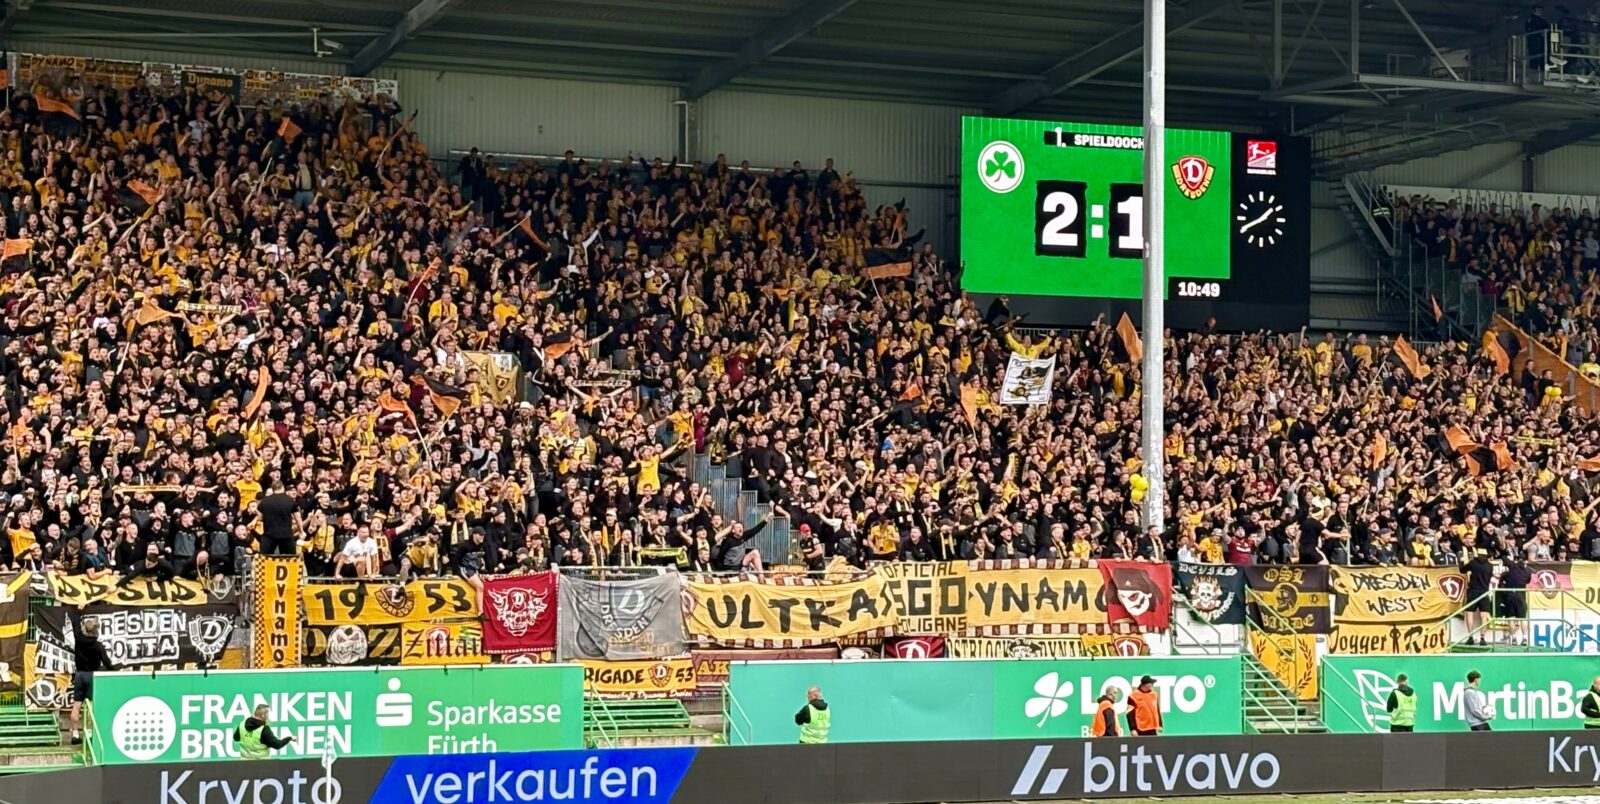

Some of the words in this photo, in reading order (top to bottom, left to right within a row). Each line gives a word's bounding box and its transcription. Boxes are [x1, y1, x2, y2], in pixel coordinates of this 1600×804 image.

[187, 72, 233, 88] Dynamo
[1055, 127, 1067, 148] 1.
[1176, 177, 1211, 199] DRESDEN
[1178, 282, 1220, 297] 10:49
[883, 562, 958, 578] OFFICIAL
[1178, 563, 1238, 576] DEVILS
[1350, 573, 1431, 593] DRESDEN
[423, 583, 472, 614] 53
[1365, 596, 1424, 616] WEST
[96, 611, 187, 636] RESDEN
[403, 627, 486, 659] Zittau
[1404, 624, 1446, 654] Riot
[1534, 624, 1600, 652] HOF
[675, 666, 694, 683] 53
[181, 691, 352, 724] FRANKEN
[427, 698, 561, 731] Sparkasse
[428, 733, 497, 755] Fürth
[1084, 741, 1281, 793] bitvavo
[160, 769, 342, 804] Krypto
[405, 756, 657, 804] verkaufen
